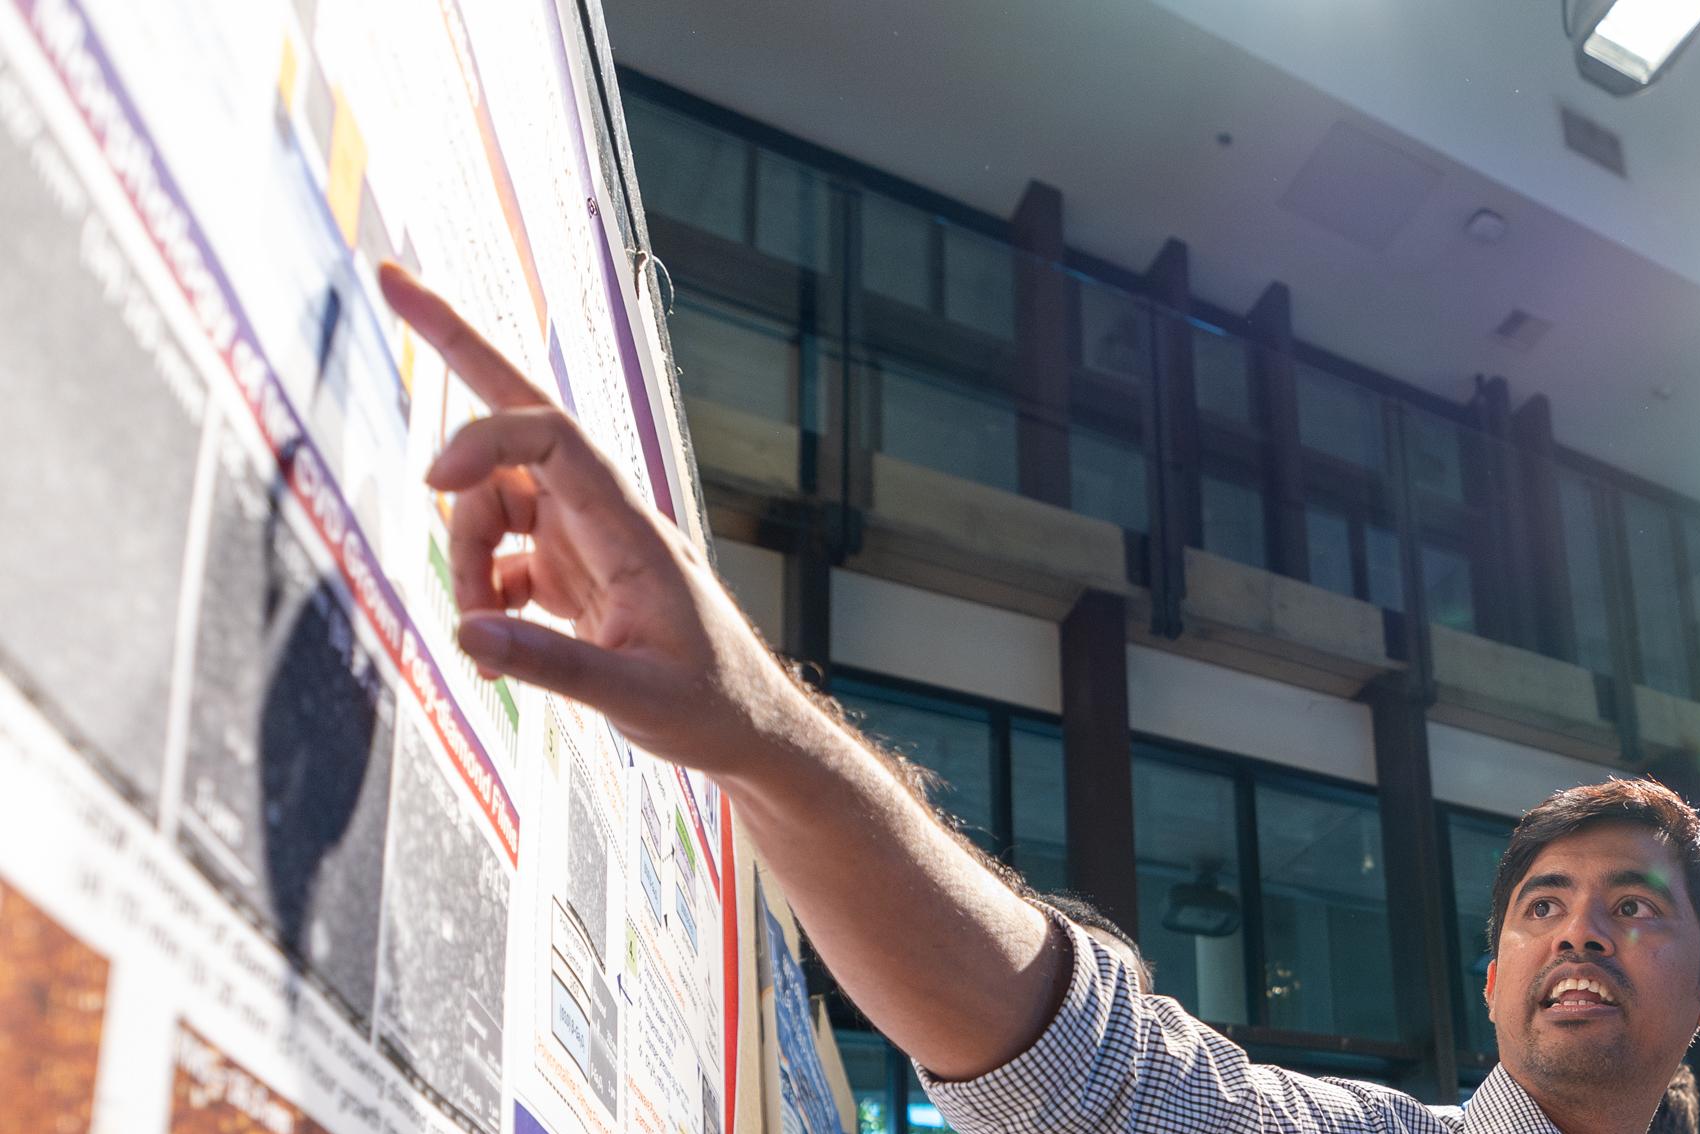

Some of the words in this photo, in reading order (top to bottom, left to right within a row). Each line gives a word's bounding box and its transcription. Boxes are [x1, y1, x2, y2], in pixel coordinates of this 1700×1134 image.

[293, 446, 346, 546] CVD
[343, 529, 402, 652] Grown
[401, 628, 492, 806] Poly-diamond
[491, 783, 519, 854] Films
